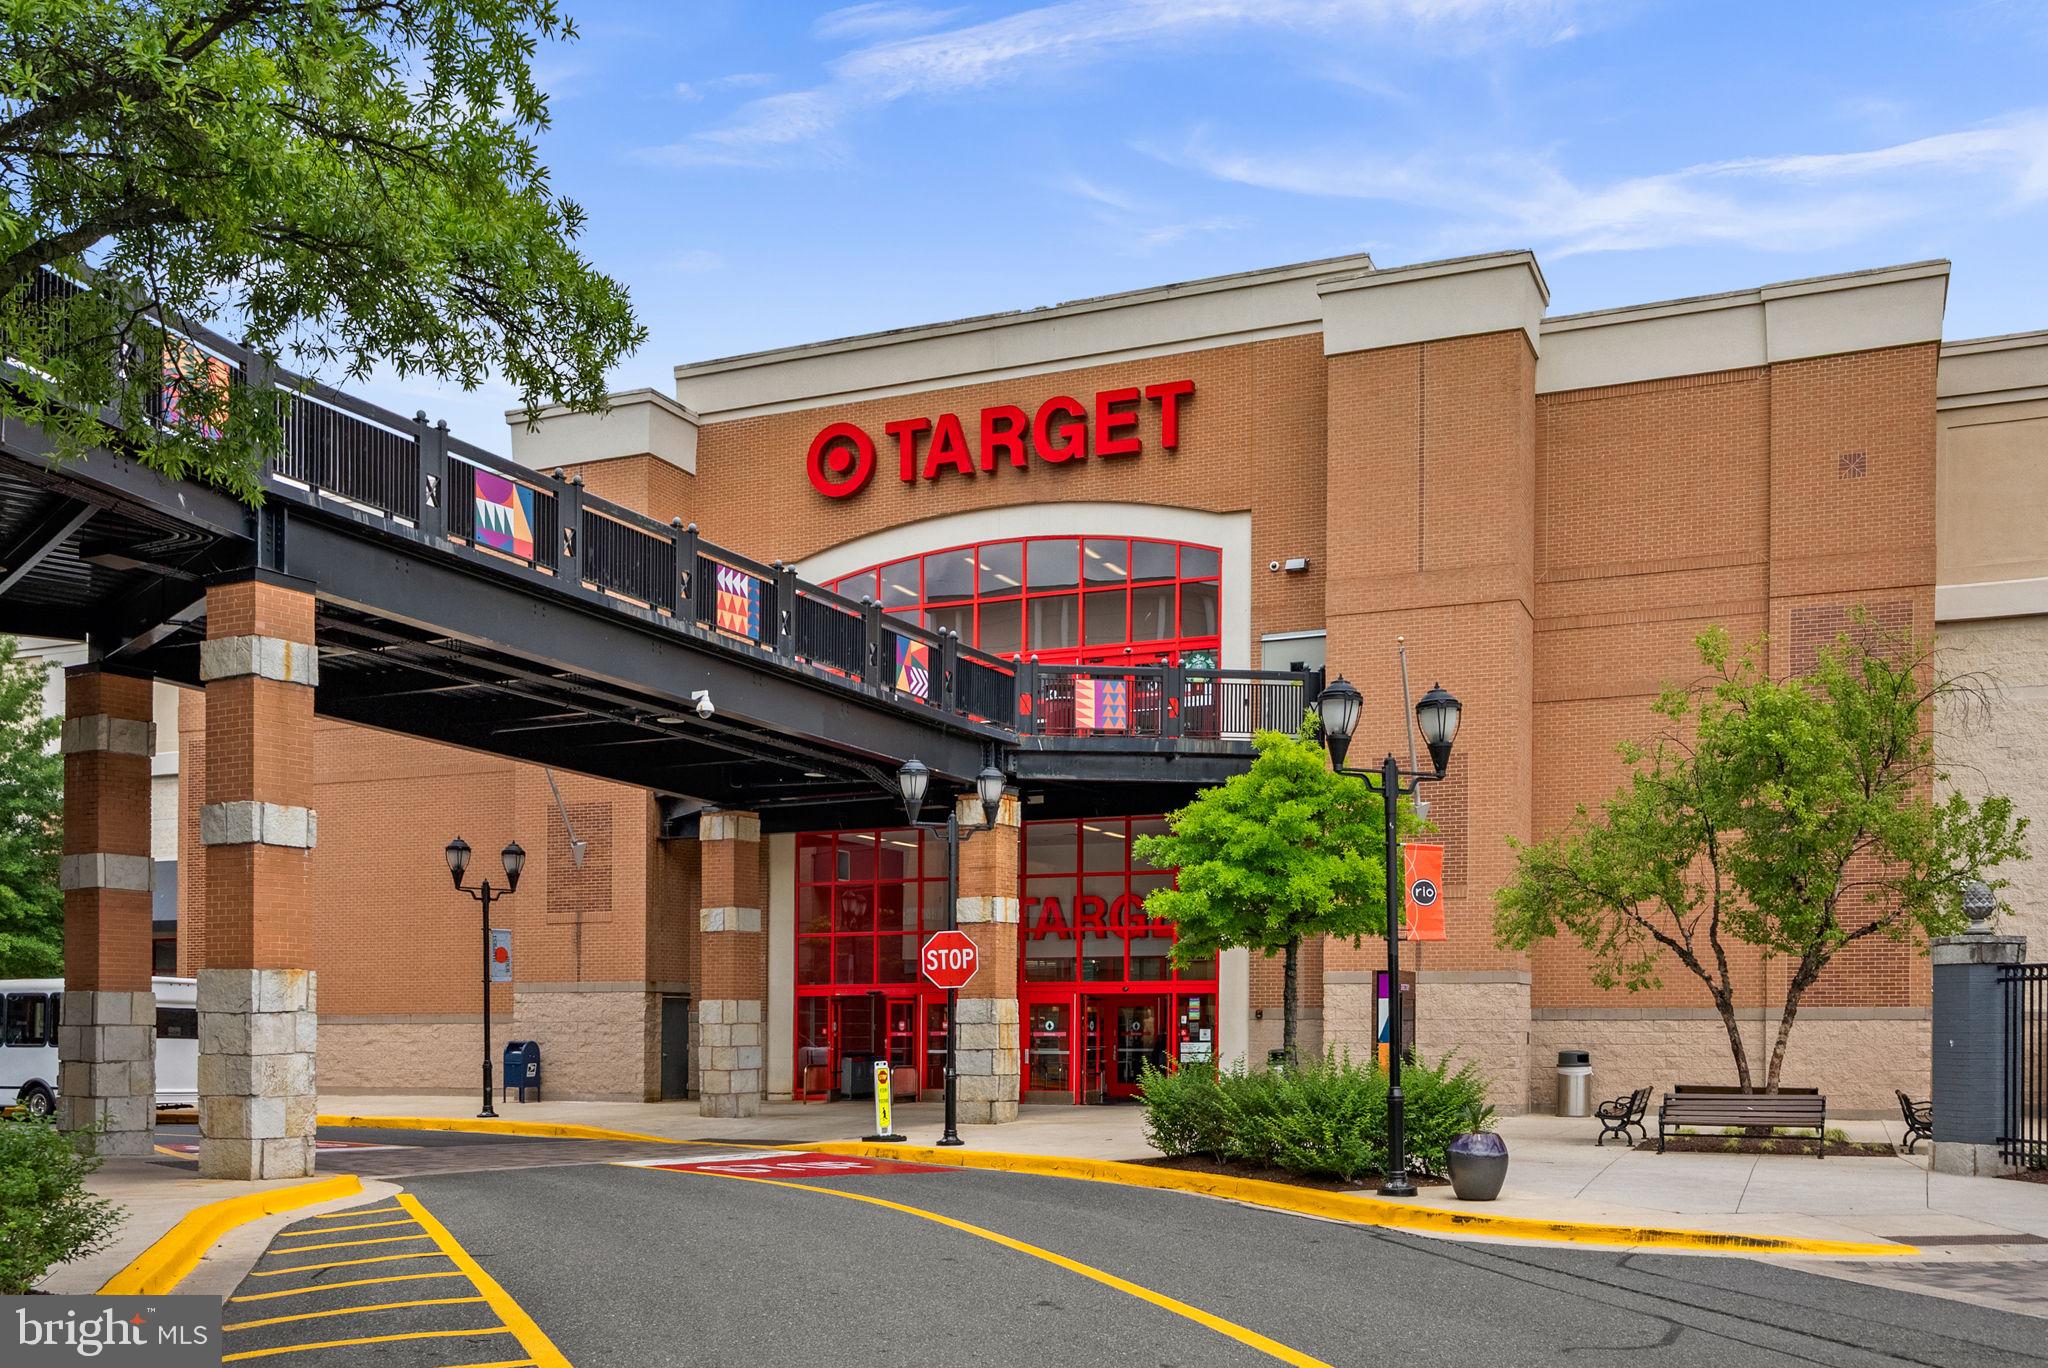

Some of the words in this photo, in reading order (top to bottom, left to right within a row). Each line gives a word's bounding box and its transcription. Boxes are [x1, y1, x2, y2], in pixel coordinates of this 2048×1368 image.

[885, 379, 1196, 483] TARGET
[1415, 886, 1434, 897] rio
[926, 948, 974, 970] STOP
